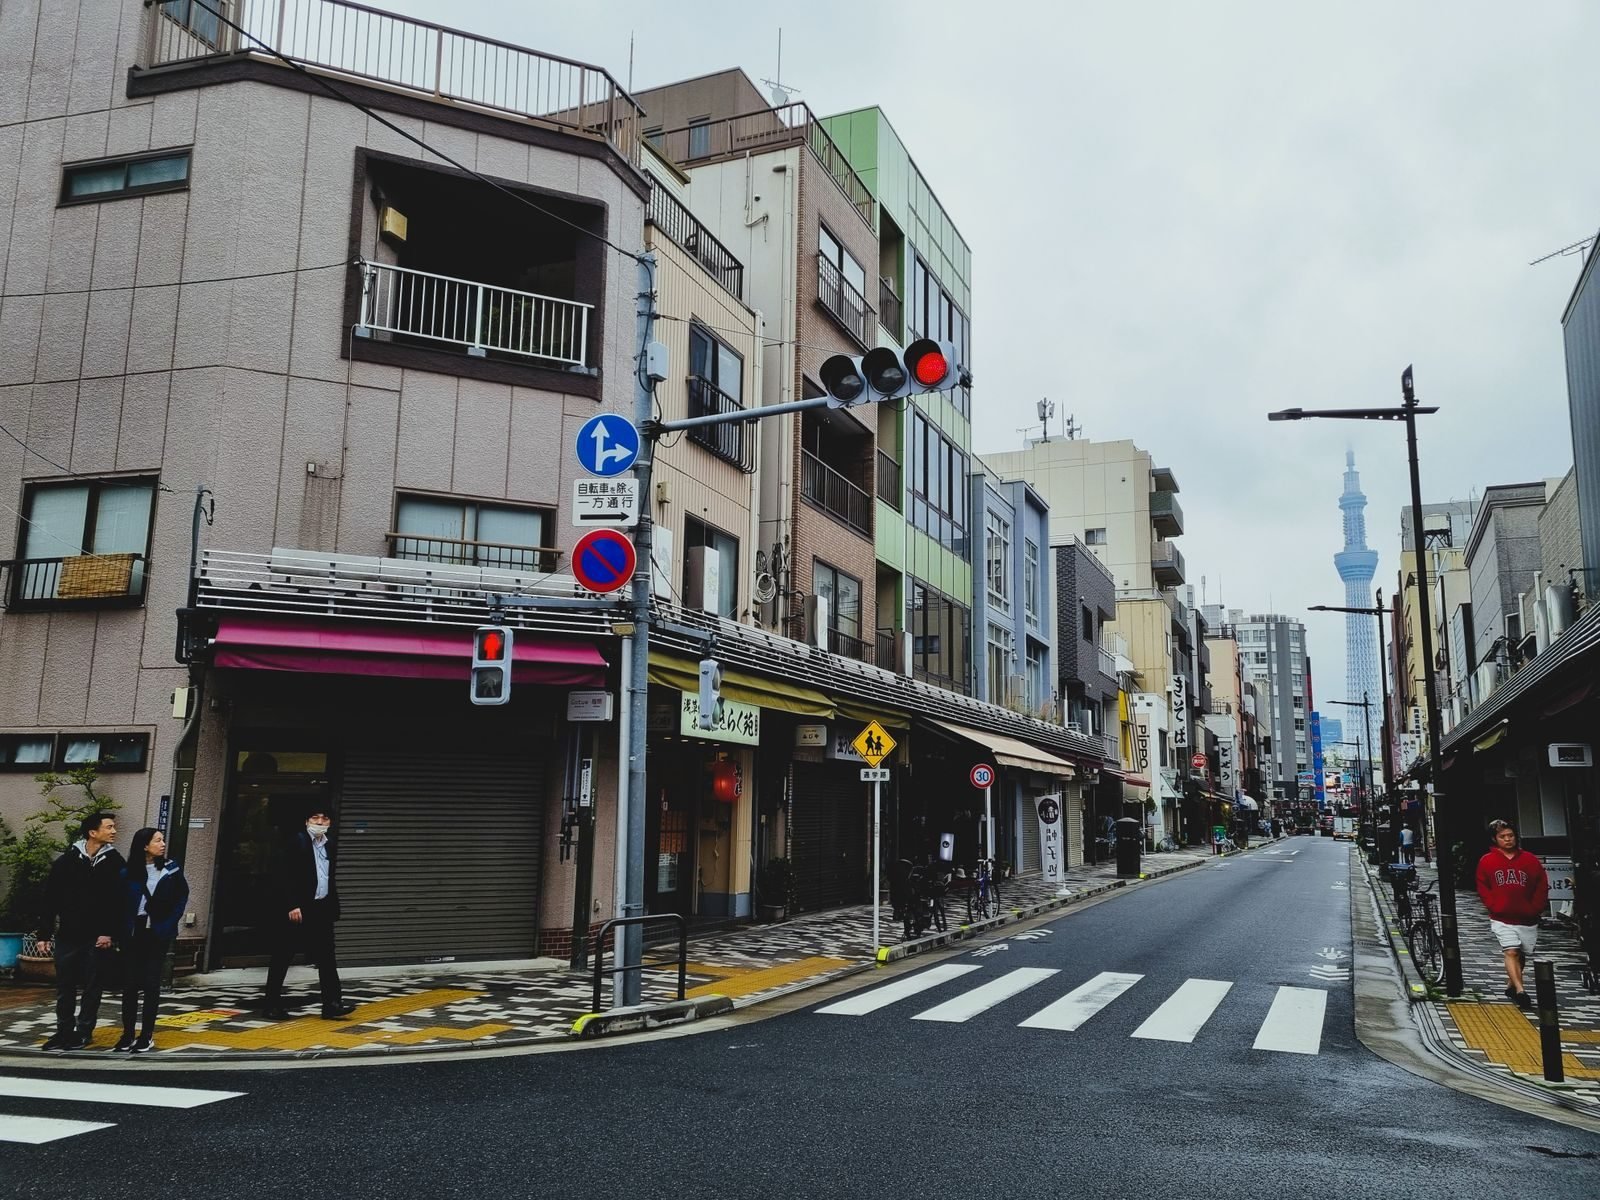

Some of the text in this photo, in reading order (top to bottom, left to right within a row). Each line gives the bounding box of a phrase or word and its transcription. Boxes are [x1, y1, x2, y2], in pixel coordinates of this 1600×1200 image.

[578, 483, 634, 494] 自転車を除く
[578, 496, 633, 508] 一方通行
[864, 771, 886, 779] 通学路
[975, 770, 989, 782] 30
[1494, 868, 1529, 886] GAP
